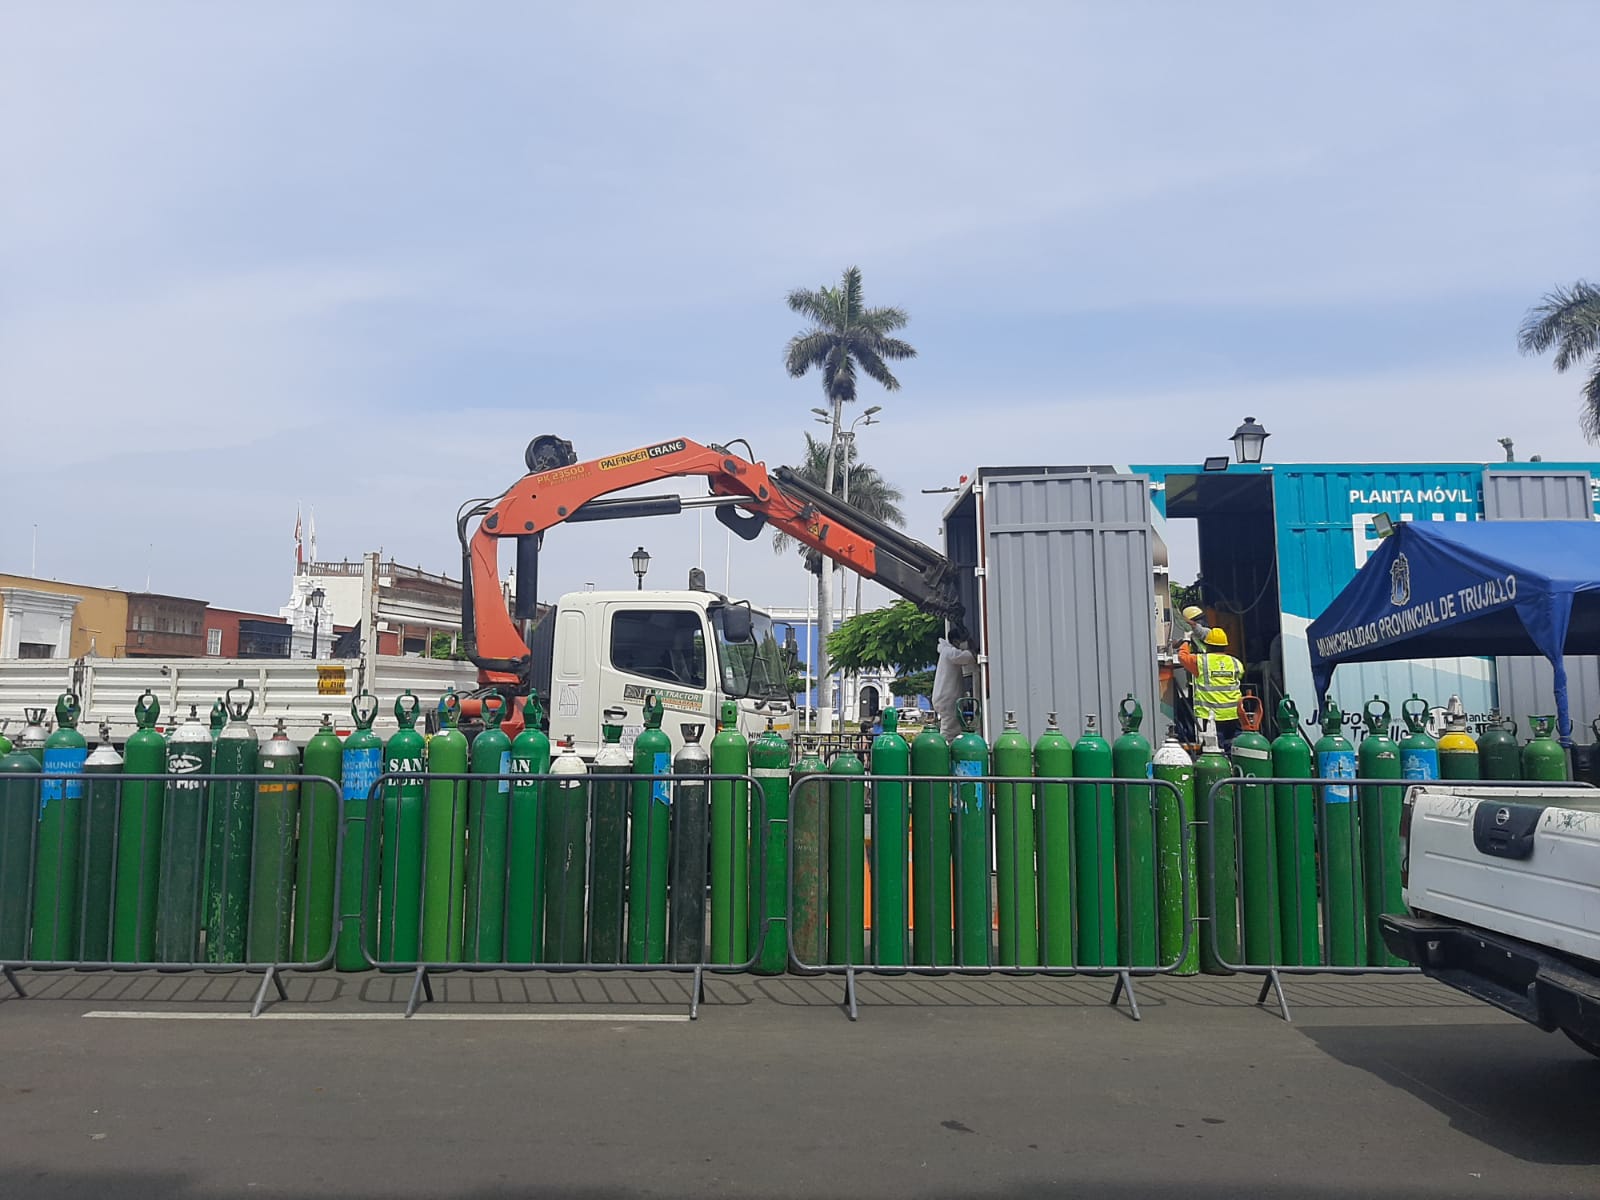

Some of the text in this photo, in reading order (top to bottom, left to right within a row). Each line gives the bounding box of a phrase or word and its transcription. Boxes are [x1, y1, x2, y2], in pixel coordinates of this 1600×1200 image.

[600, 441, 682, 470] PALFINGER CRANE
[552, 466, 585, 481] 23500
[1350, 490, 1414, 503] PLANTA
[1417, 486, 1472, 503] MÓVIL
[1316, 574, 1516, 657] MUNICIPALIDAD PROVINCIAL DE TRUJILLO
[389, 758, 423, 772] SAN
